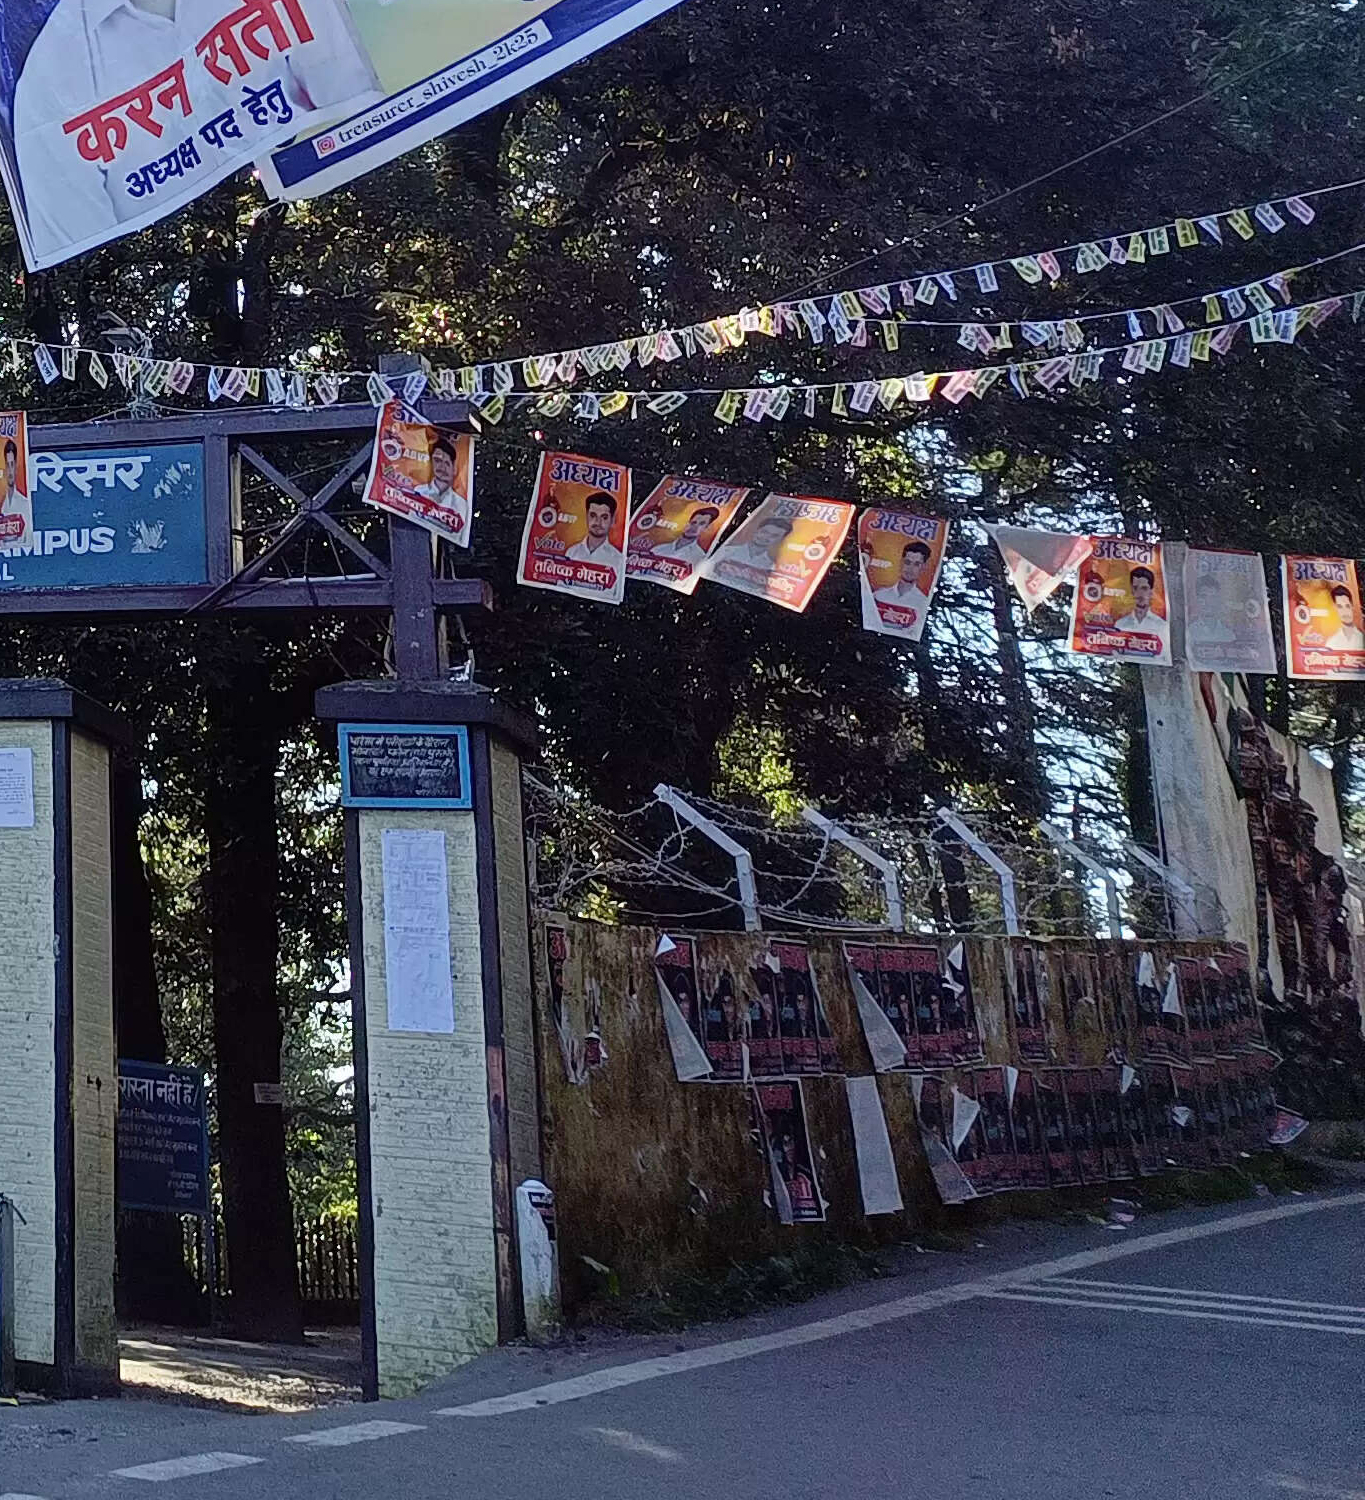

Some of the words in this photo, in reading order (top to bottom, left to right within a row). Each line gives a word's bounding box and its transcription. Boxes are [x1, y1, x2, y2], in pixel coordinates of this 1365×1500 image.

[62, 58, 192, 163] करन
[125, 137, 201, 198] अध्यक्ष
[198, 108, 243, 148] पद
[241, 79, 292, 126] हेतु
[549, 459, 620, 492] अध्यक्ष
[156, 1075, 181, 1108] नहीं
